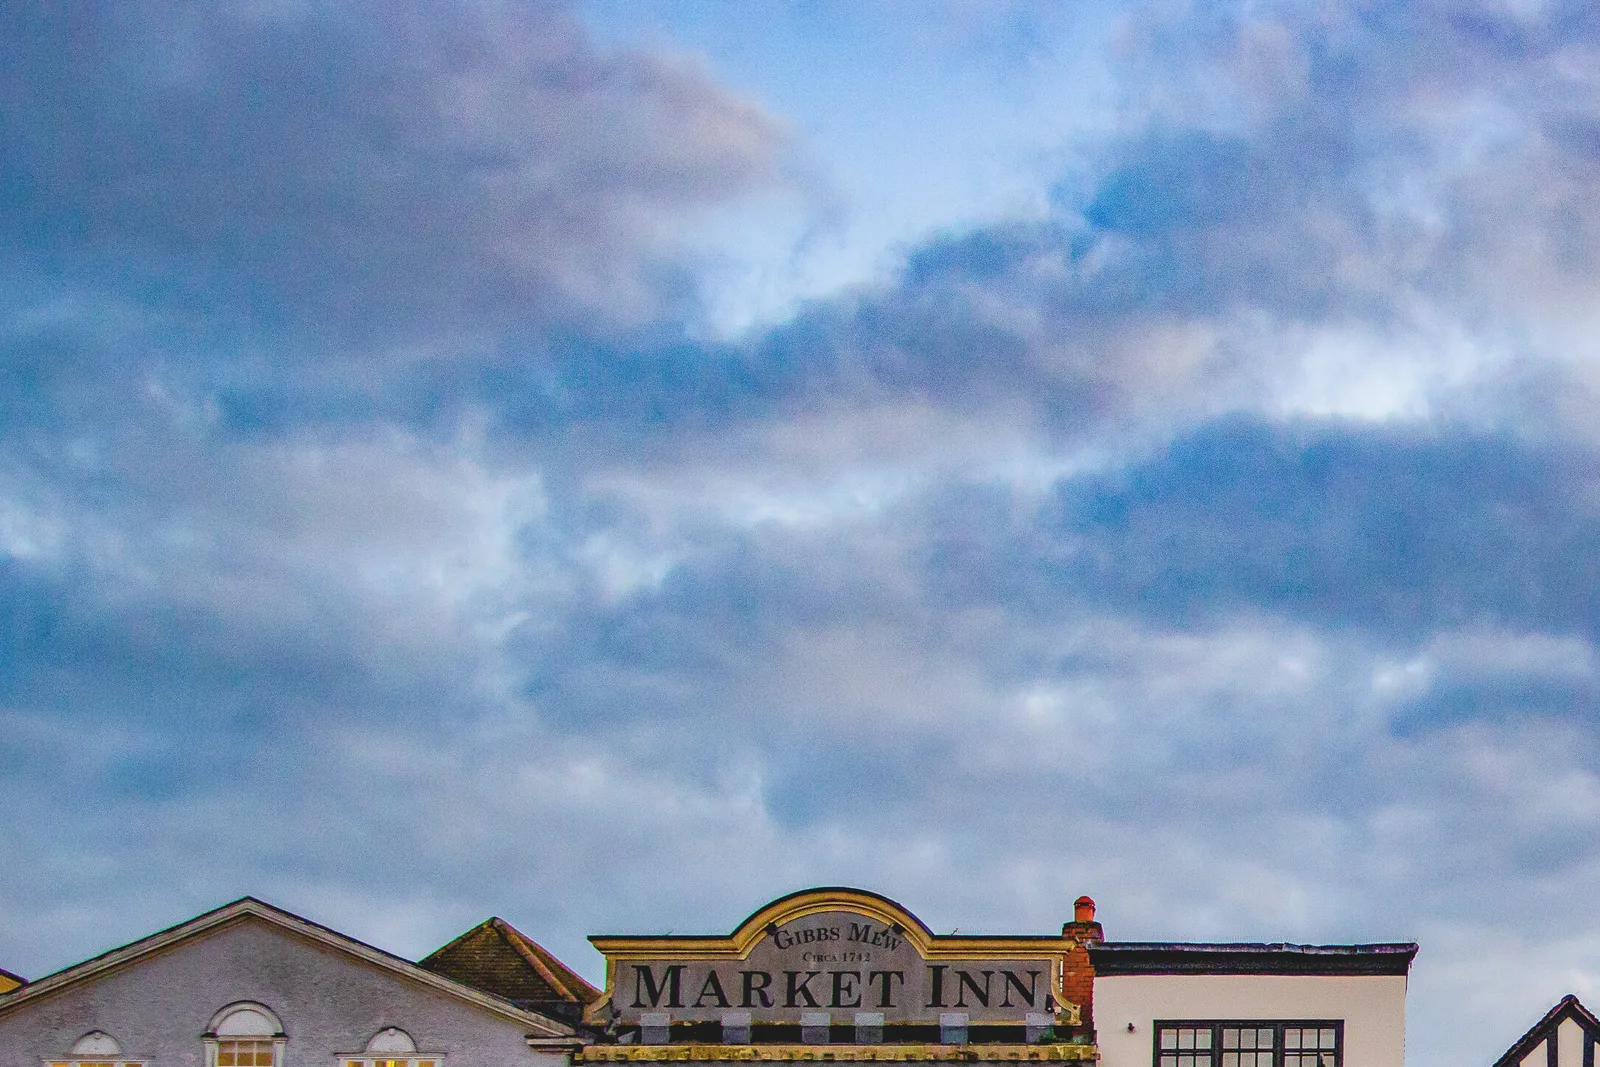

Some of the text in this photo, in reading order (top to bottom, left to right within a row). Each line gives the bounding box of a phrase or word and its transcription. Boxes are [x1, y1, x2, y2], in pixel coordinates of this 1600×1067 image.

[774, 922, 902, 951] GIBBS MEW
[803, 951, 871, 962] CIRCA 1742
[631, 964, 1043, 1009] MARKET INN
